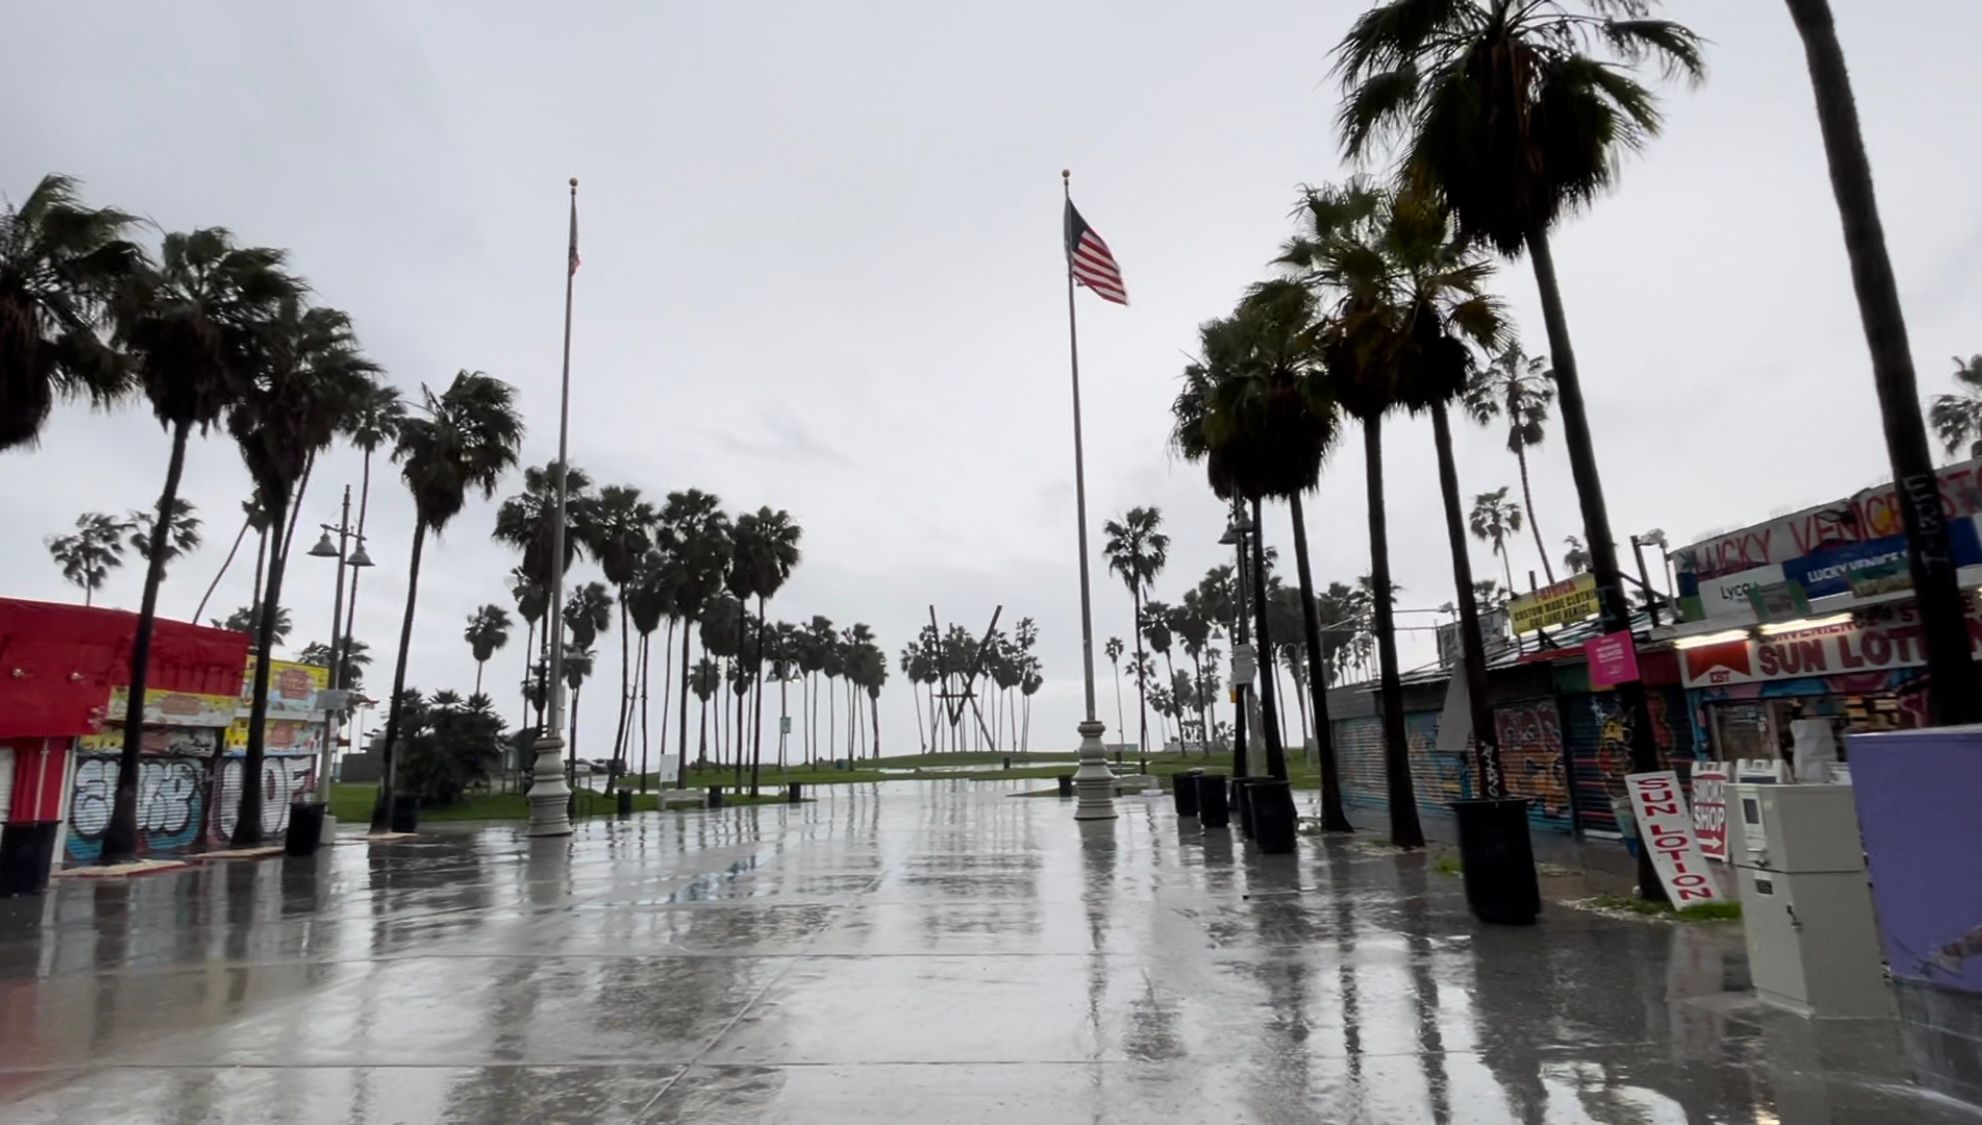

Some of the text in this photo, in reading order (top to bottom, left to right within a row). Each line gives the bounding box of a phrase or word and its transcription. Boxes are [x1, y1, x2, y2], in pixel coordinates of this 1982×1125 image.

[1757, 638, 1828, 677] SUN
[1693, 804, 1726, 832] SHOP
[1637, 777, 1713, 901] SUN LOTION
